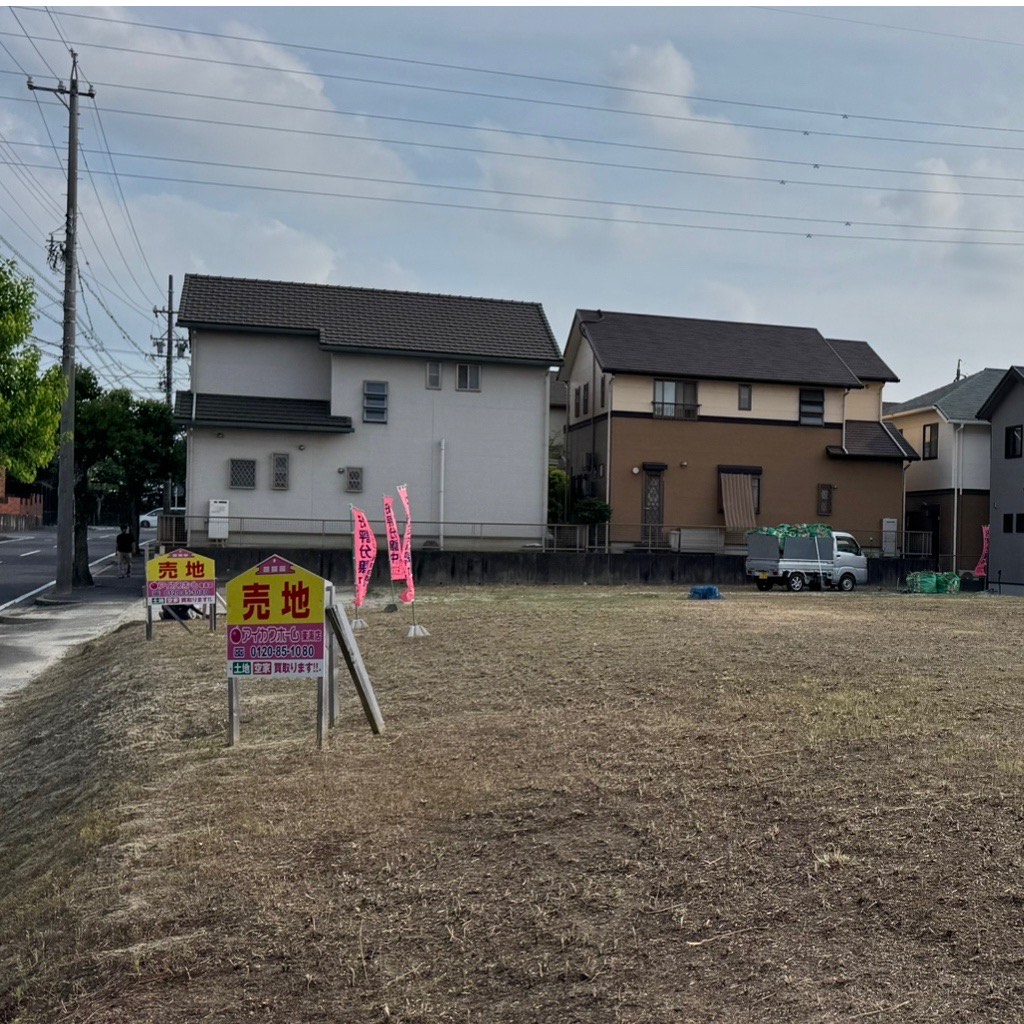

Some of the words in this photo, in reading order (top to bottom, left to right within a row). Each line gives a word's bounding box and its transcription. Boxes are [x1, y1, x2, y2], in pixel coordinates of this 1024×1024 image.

[158, 560, 205, 579] 売地
[242, 580, 311, 621] 売地
[241, 626, 301, 644] アイカワホーム
[250, 644, 315, 658] 0120-85-1080
[233, 663, 251, 674] 土地
